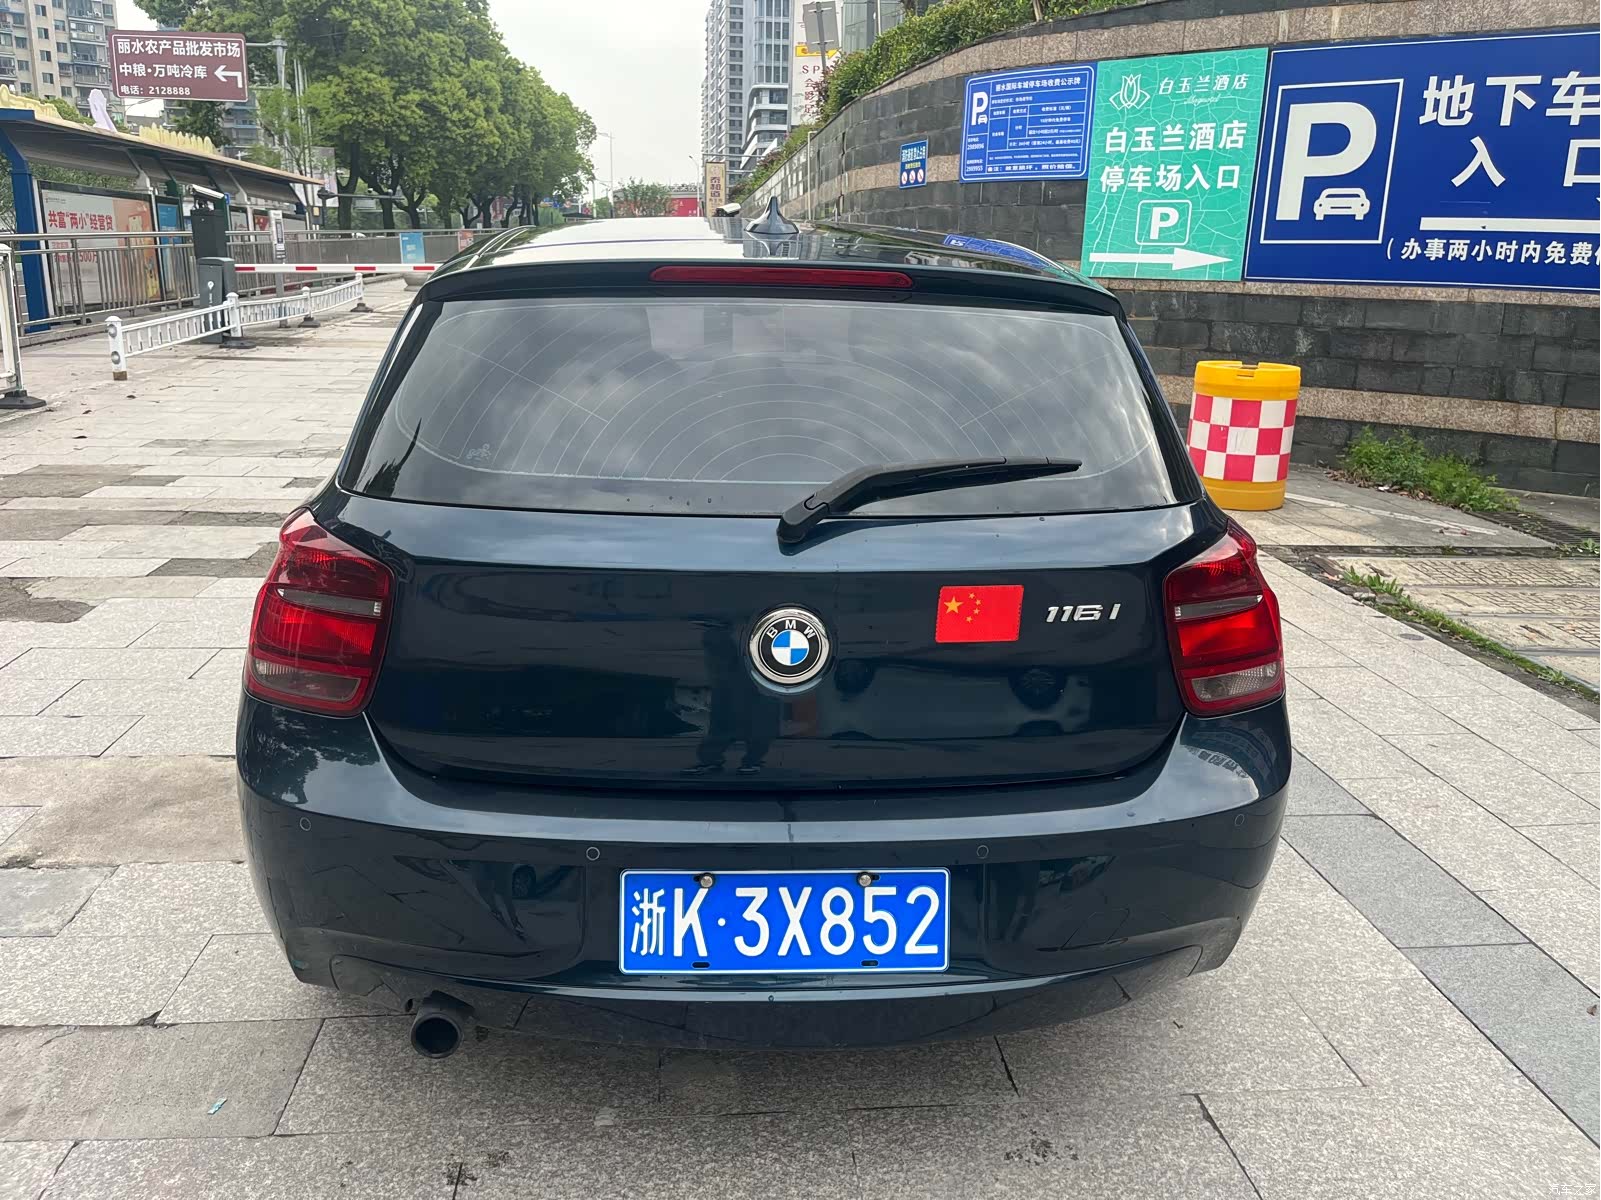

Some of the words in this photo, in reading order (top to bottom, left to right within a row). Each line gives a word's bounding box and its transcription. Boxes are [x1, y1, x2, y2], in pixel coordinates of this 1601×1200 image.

[117, 38, 241, 58] 丽水农产品批发市场
[119, 62, 208, 79] 中粮·万吨冷库
[1158, 74, 1250, 95] 白玉兰酒店
[1105, 120, 1248, 153] 白玉兰酒店
[1100, 163, 1241, 193] 停车场入口
[1150, 206, 1180, 240] P
[1386, 238, 1600, 267] （办事两小时内免费
[766, 619, 816, 639] BMW
[631, 886, 940, 957] 浙K·3X852
